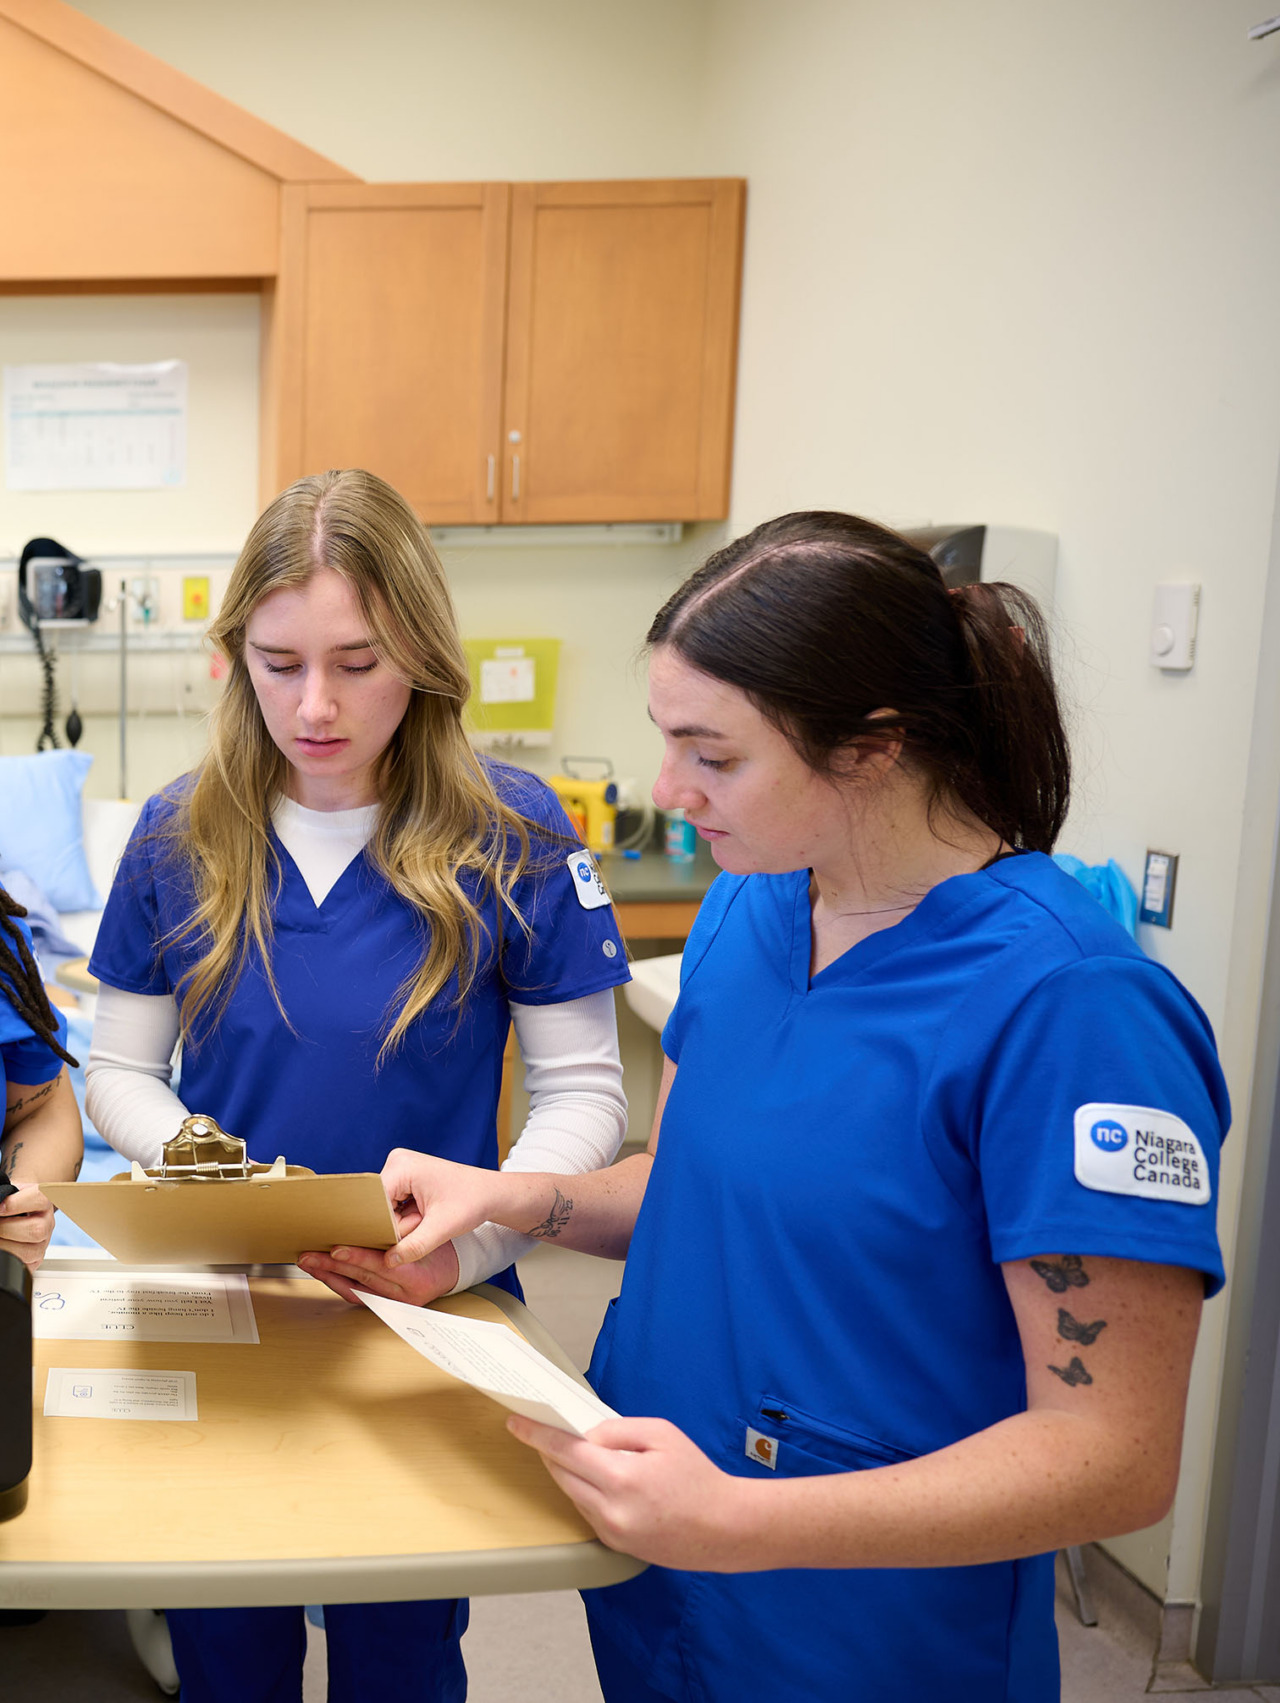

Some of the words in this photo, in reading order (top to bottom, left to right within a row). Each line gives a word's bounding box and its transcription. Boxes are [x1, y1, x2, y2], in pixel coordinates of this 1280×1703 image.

[1096, 1127, 1123, 1143] nc
[1135, 1129, 1197, 1155] Niagara
[1134, 1146, 1199, 1175] College
[1133, 1164, 1201, 1190] Canada
